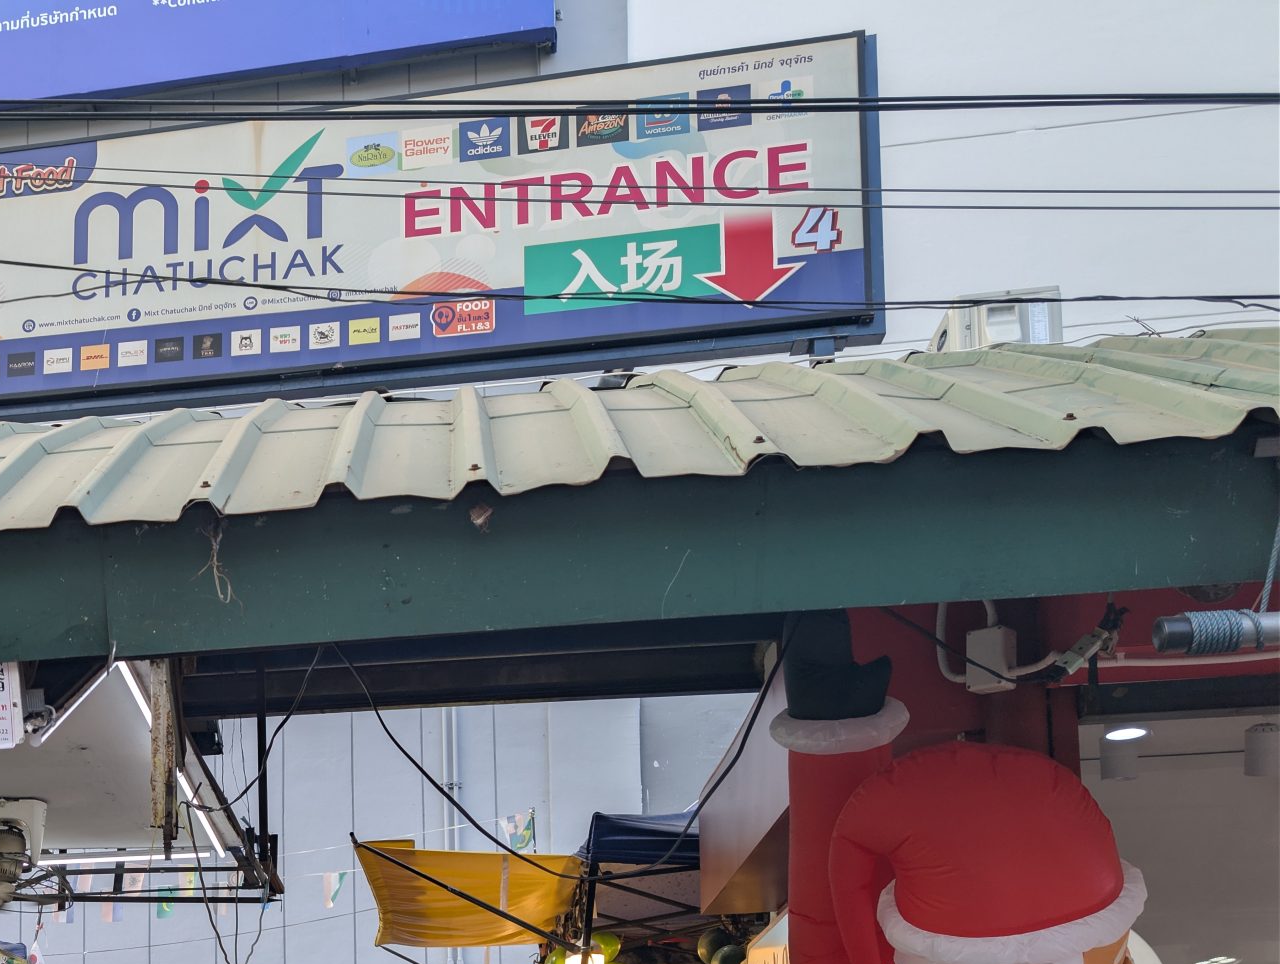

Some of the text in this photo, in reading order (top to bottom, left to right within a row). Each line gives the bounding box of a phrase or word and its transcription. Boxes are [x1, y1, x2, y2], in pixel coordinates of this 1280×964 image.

[698, 54, 814, 80] ศูนย์การค้า มิกซ์ จตุจักร
[645, 124, 682, 136] watsons
[404, 135, 450, 149] Flower
[404, 144, 450, 158] Gallery
[467, 144, 503, 157] adidas
[12, 157, 78, 194] Food
[404, 143, 810, 239] ENTRANCE
[790, 206, 843, 254] 4
[71, 243, 345, 302] CHATUCHAK
[560, 239, 683, 303] 入场
[144, 309, 160, 318] Mixt
[161, 305, 198, 316] Chatuchak
[456, 300, 490, 313] FOOD
[38, 313, 122, 329] www.mixtchatuchak.com
